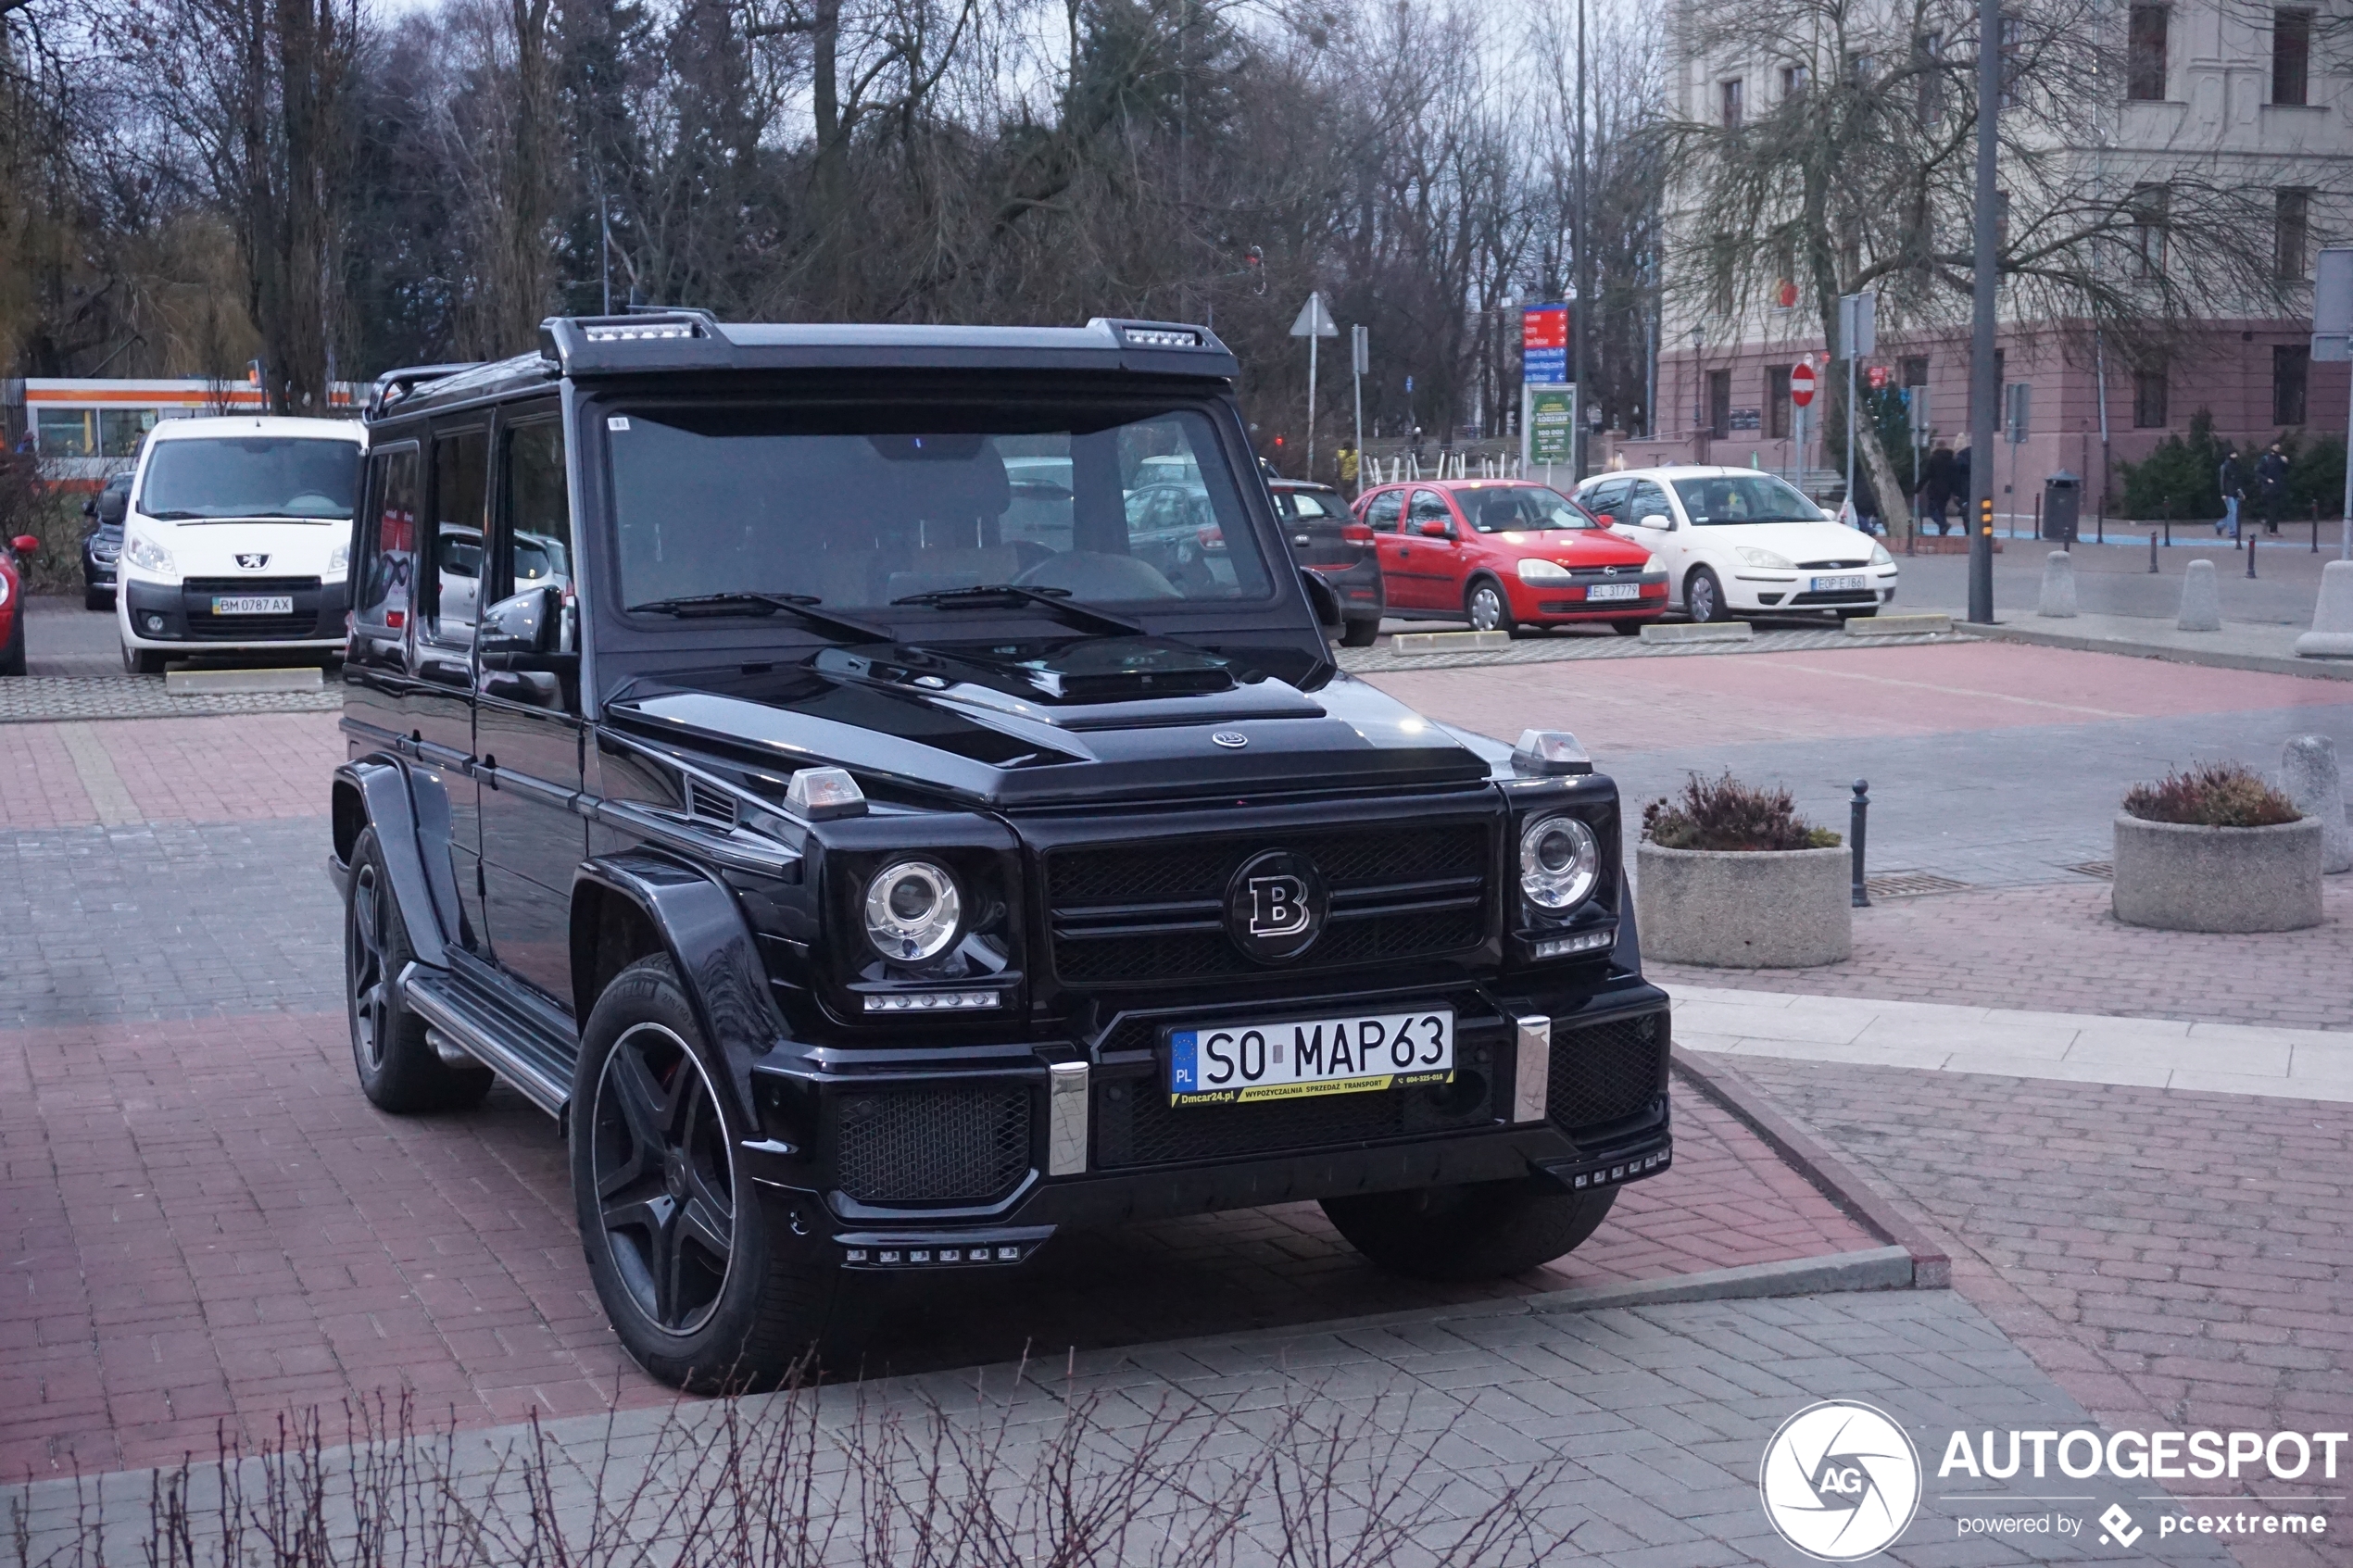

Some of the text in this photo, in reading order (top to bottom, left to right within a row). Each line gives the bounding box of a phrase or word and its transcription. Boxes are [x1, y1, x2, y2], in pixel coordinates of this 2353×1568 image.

[1593, 584, 1638, 597] EL 3T779
[220, 598, 290, 611] BM 0787 AX
[1249, 874, 1311, 937] B
[1206, 1015, 1444, 1084] SO MAP63
[1176, 1069, 1192, 1084] PL
[1406, 1073, 1443, 1084] 604-325-016
[1245, 1079, 1383, 1098] WYPOŻYCZALNIA SPRZEDAŻ TRANSPORT
[1181, 1090, 1235, 1104] Dmcar24.pl
